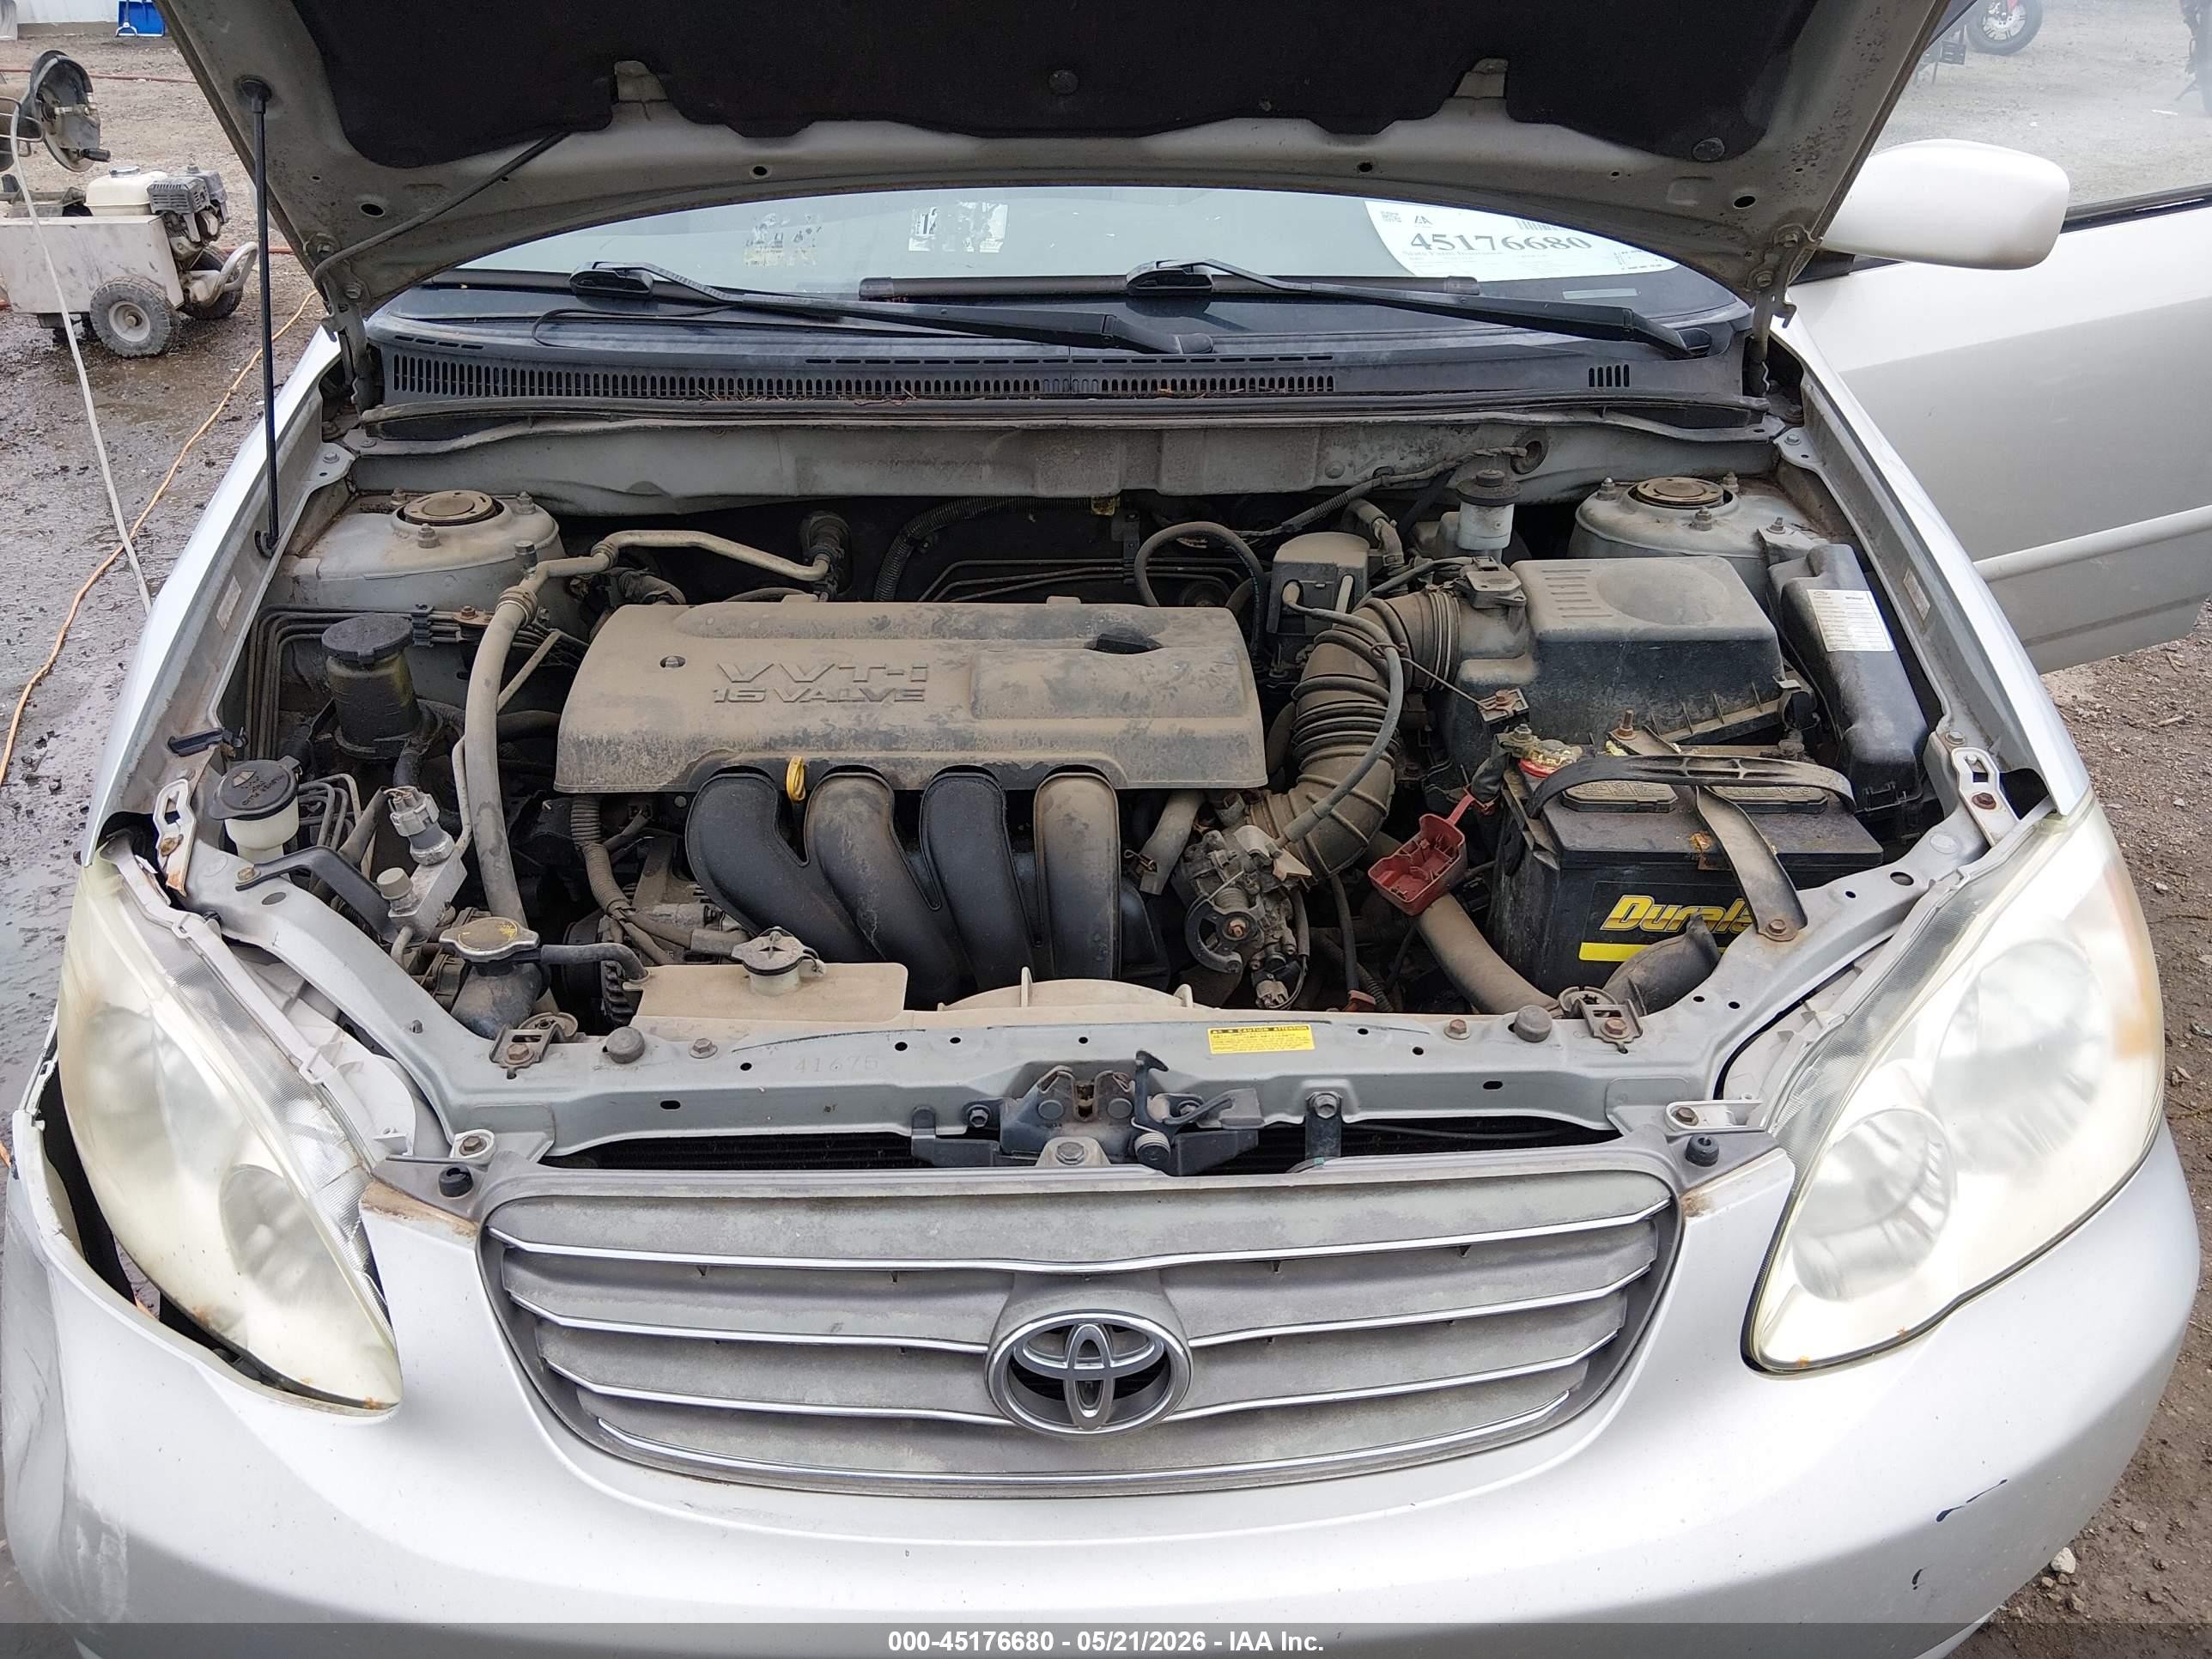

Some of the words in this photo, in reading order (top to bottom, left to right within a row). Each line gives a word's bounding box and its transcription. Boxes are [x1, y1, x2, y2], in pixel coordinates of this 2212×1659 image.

[1410, 233, 1593, 251] 45176680
[713, 687, 766, 703] 16
[774, 687, 926, 703] VALVE
